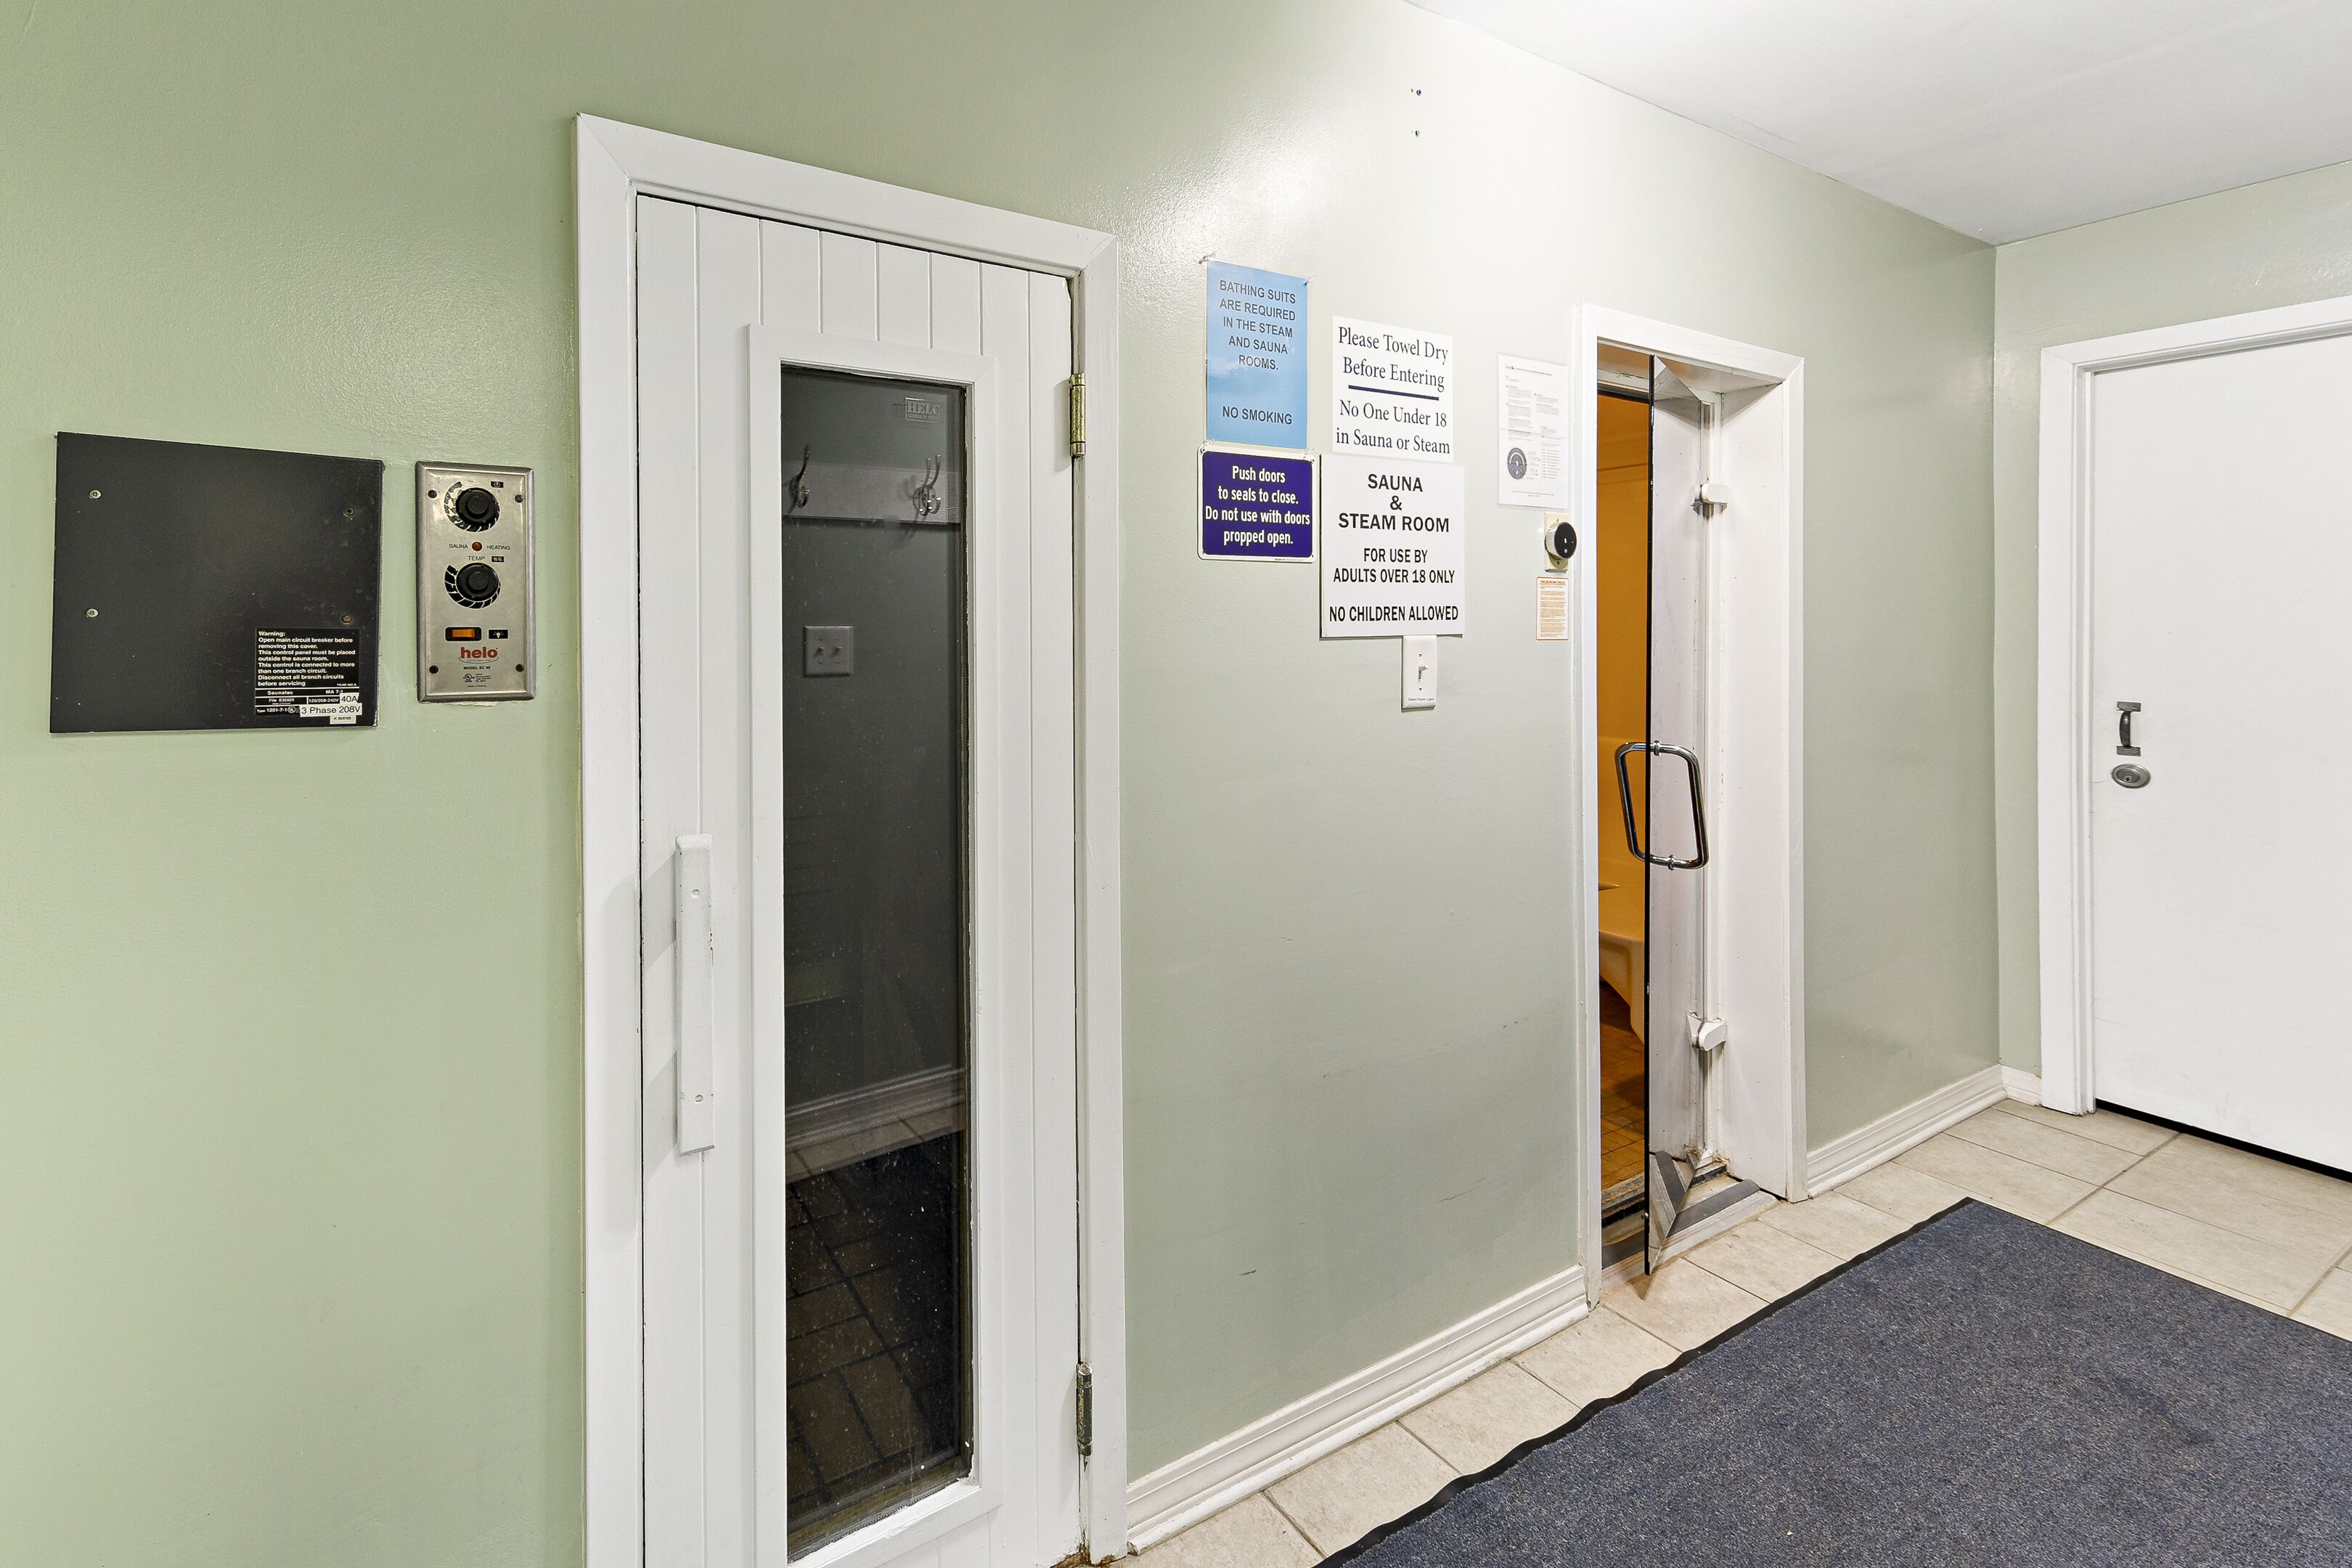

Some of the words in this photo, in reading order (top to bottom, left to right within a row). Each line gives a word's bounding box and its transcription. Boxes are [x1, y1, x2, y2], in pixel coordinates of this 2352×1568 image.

[1220, 279, 1265, 298] BATHING
[1268, 289, 1296, 303] SUITS
[1220, 298, 1241, 311] ARE
[1244, 303, 1295, 321] REQUIRED
[1223, 317, 1233, 327] IN
[1236, 319, 1256, 331] THE
[1259, 323, 1292, 338] STEAM
[1229, 336, 1249, 348] AND
[1254, 340, 1288, 354] SAUNA
[1339, 327, 1379, 349] Please
[1384, 334, 1420, 356] Towel
[1424, 342, 1448, 365] Dry
[1238, 355, 1278, 370] ROOMS.
[1343, 356, 1385, 378] Before
[1390, 364, 1445, 392] Entering
[1222, 406, 1238, 418] NO
[1242, 409, 1292, 425] SMOKING
[1340, 399, 1358, 417] No
[1363, 403, 1389, 420] One
[1393, 407, 1430, 425] Under
[1436, 412, 1446, 427] 18
[1336, 428, 1349, 444] in
[1354, 429, 1392, 448] Sauna
[1397, 438, 1409, 449] or
[1414, 436, 1450, 454] Steam
[1233, 465, 1256, 481] Push
[1259, 468, 1286, 483] doors
[1368, 474, 1423, 492] SAUNA
[1218, 486, 1228, 499] to
[1231, 488, 1256, 502] seals
[1259, 489, 1268, 502] to
[1272, 490, 1299, 504] close.
[1390, 495, 1402, 510] &
[1205, 506, 1218, 520] Do
[1222, 507, 1238, 521] not
[1241, 510, 1257, 522] use
[1260, 510, 1281, 523] with
[1284, 511, 1310, 525] doors
[1339, 513, 1395, 530] STEAM
[1402, 516, 1449, 532] ROOM
[1224, 530, 1265, 546] propped
[1267, 533, 1293, 547] open.
[1364, 548, 1386, 562] FOR
[1390, 549, 1410, 563] USE
[1415, 550, 1427, 563] BY
[1334, 568, 1376, 582] ADULTS
[1380, 569, 1408, 583] OVER
[1413, 570, 1425, 583] 18
[1429, 570, 1455, 583] ONLY
[1330, 606, 1345, 621] NO
[1349, 606, 1405, 621] CHILDREN
[1409, 605, 1458, 621] ALLOWED
[461, 647, 498, 658] helo
